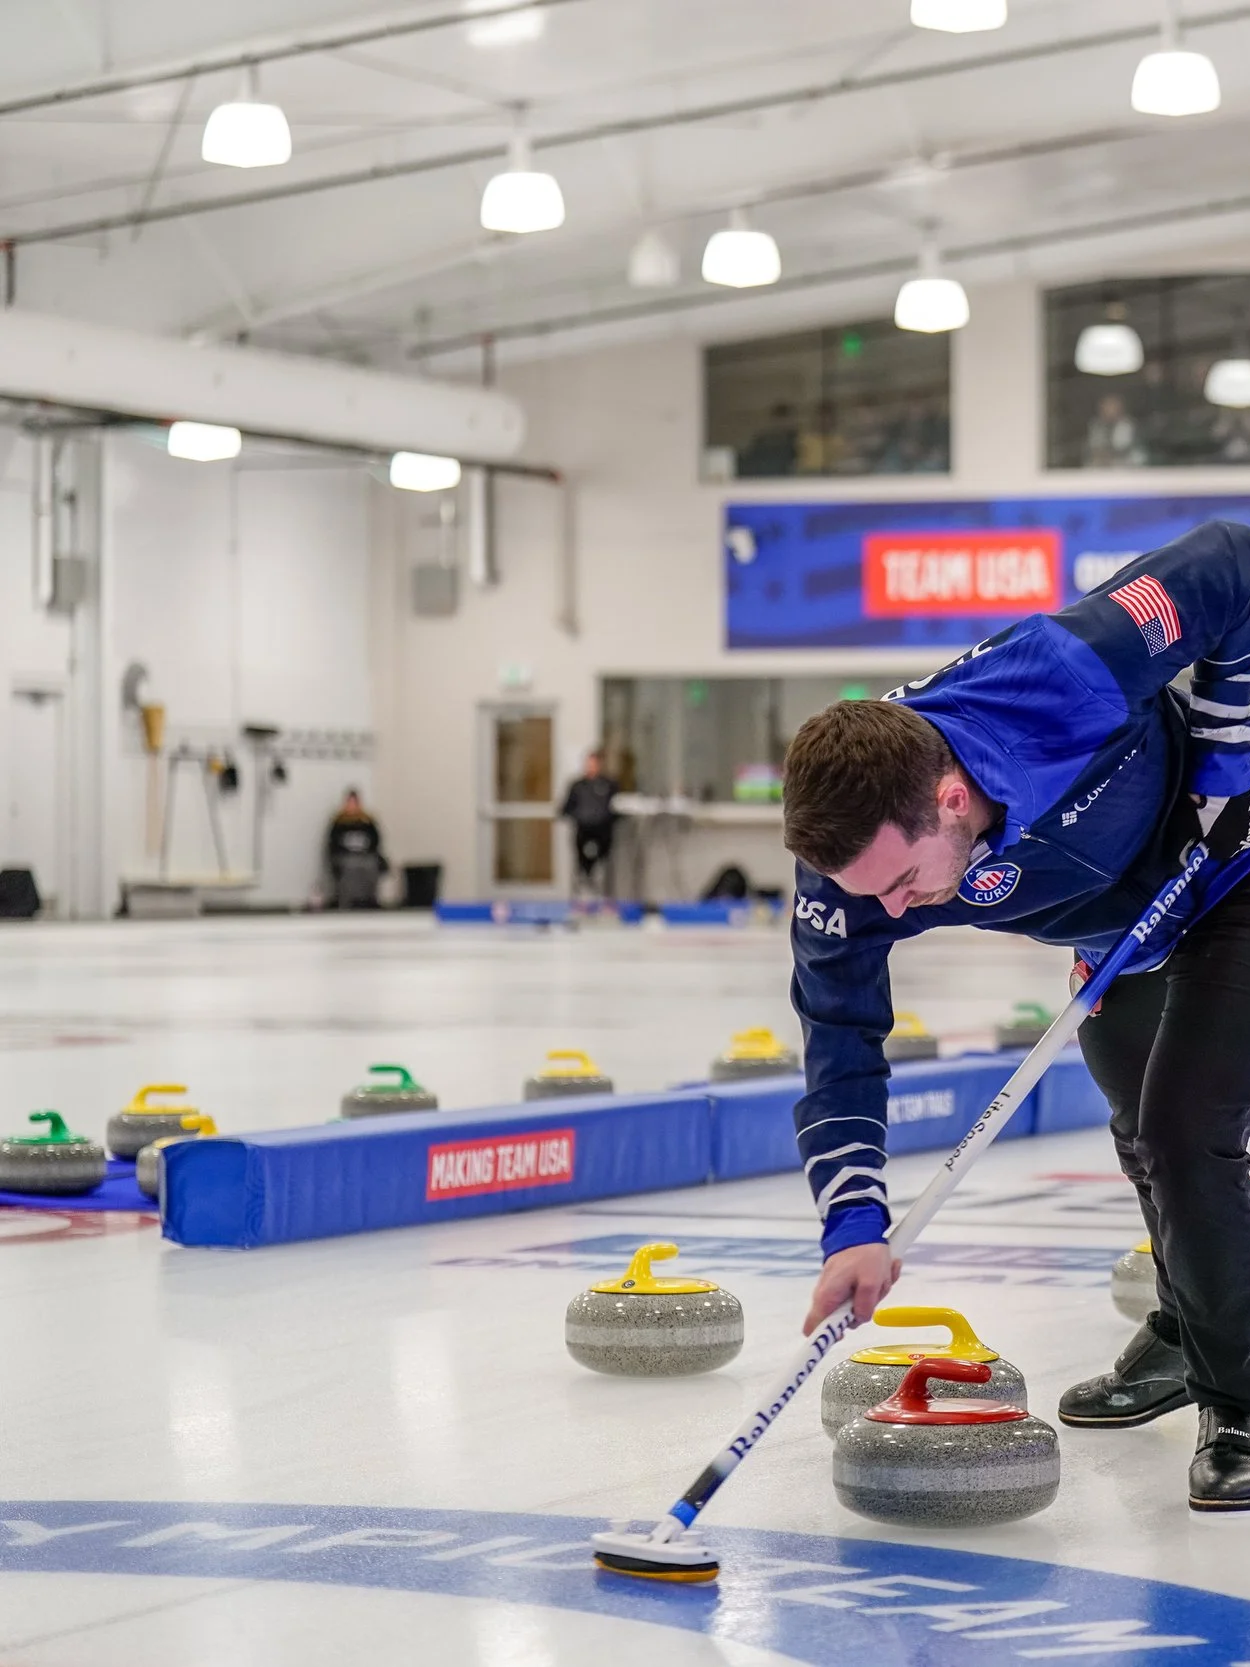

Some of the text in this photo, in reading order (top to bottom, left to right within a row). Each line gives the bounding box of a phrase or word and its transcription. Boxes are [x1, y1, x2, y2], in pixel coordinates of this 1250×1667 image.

[881, 546, 1051, 601] TEAM USA
[975, 870, 1017, 901] CURLIN
[796, 895, 847, 938] USA
[431, 1136, 571, 1191] MAKING TEAM USA
[0, 1519, 597, 1570] YMPIC
